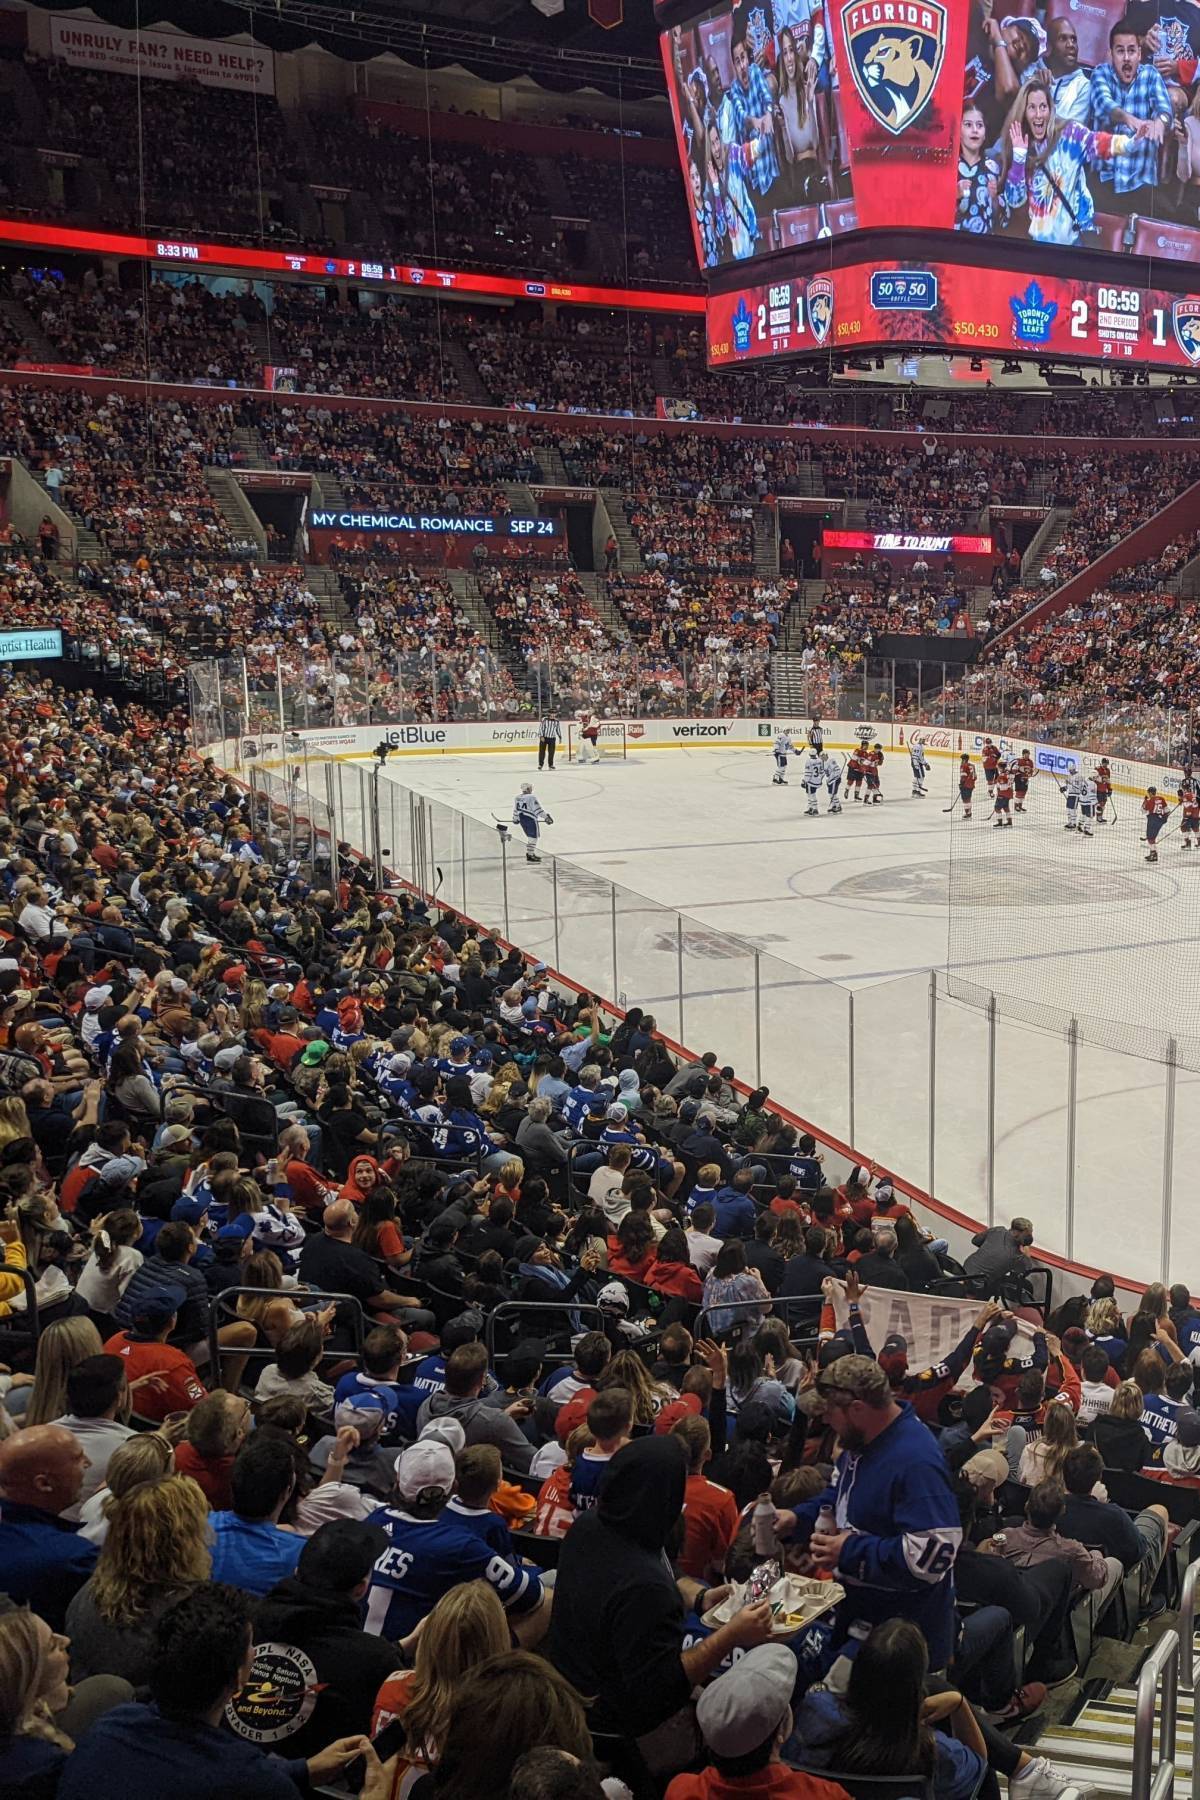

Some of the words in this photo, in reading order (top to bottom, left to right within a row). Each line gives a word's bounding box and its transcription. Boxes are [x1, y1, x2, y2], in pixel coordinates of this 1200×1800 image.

[852, 3, 932, 29] FLORIDA
[60, 30, 122, 51] UNRULY
[129, 40, 168, 58] FAN?
[174, 47, 212, 64] NEED
[219, 54, 264, 72] HELP?
[157, 244, 180, 256] 8:33
[182, 246, 198, 259] PM
[348, 264, 355, 275] 2
[361, 263, 383, 274] 06:59
[390, 268, 396, 279] 1
[878, 282, 893, 295] 50
[909, 282, 926, 295] 50
[757, 304, 766, 339] 2
[769, 285, 790, 308] 06:59
[797, 297, 805, 333] 1
[1018, 309, 1050, 323] TORONTO
[1071, 300, 1088, 338] 2
[1098, 287, 1139, 312] 06:59
[1153, 309, 1166, 346] 1
[837, 321, 861, 337] $50,430
[954, 321, 998, 338] $50,430
[1022, 318, 1044, 328] MAPLE
[1022, 325, 1045, 335] LEAFS
[1113, 316, 1137, 328] PERIOD
[1098, 330, 1116, 339] SHOTS
[1125, 332, 1138, 341] GOAL
[313, 513, 337, 526] MY
[340, 514, 417, 529] CHEMICAL
[420, 518, 494, 532] ROMANCE
[510, 520, 534, 533] SEP
[537, 521, 554, 534] 24
[874, 533, 901, 548] TIME
[904, 536, 920, 549] TO
[918, 536, 953, 550] HUNT
[25, 638, 56, 651] Health
[386, 727, 446, 744] jetBlue
[672, 725, 727, 736] verizon
[1038, 752, 1076, 770] GEICO
[916, 1533, 955, 1574] 16
[286, 1648, 312, 1677] NASA
[272, 1673, 301, 1687] Neptune
[275, 1665, 299, 1679] Saturn
[237, 1704, 252, 1714] and
